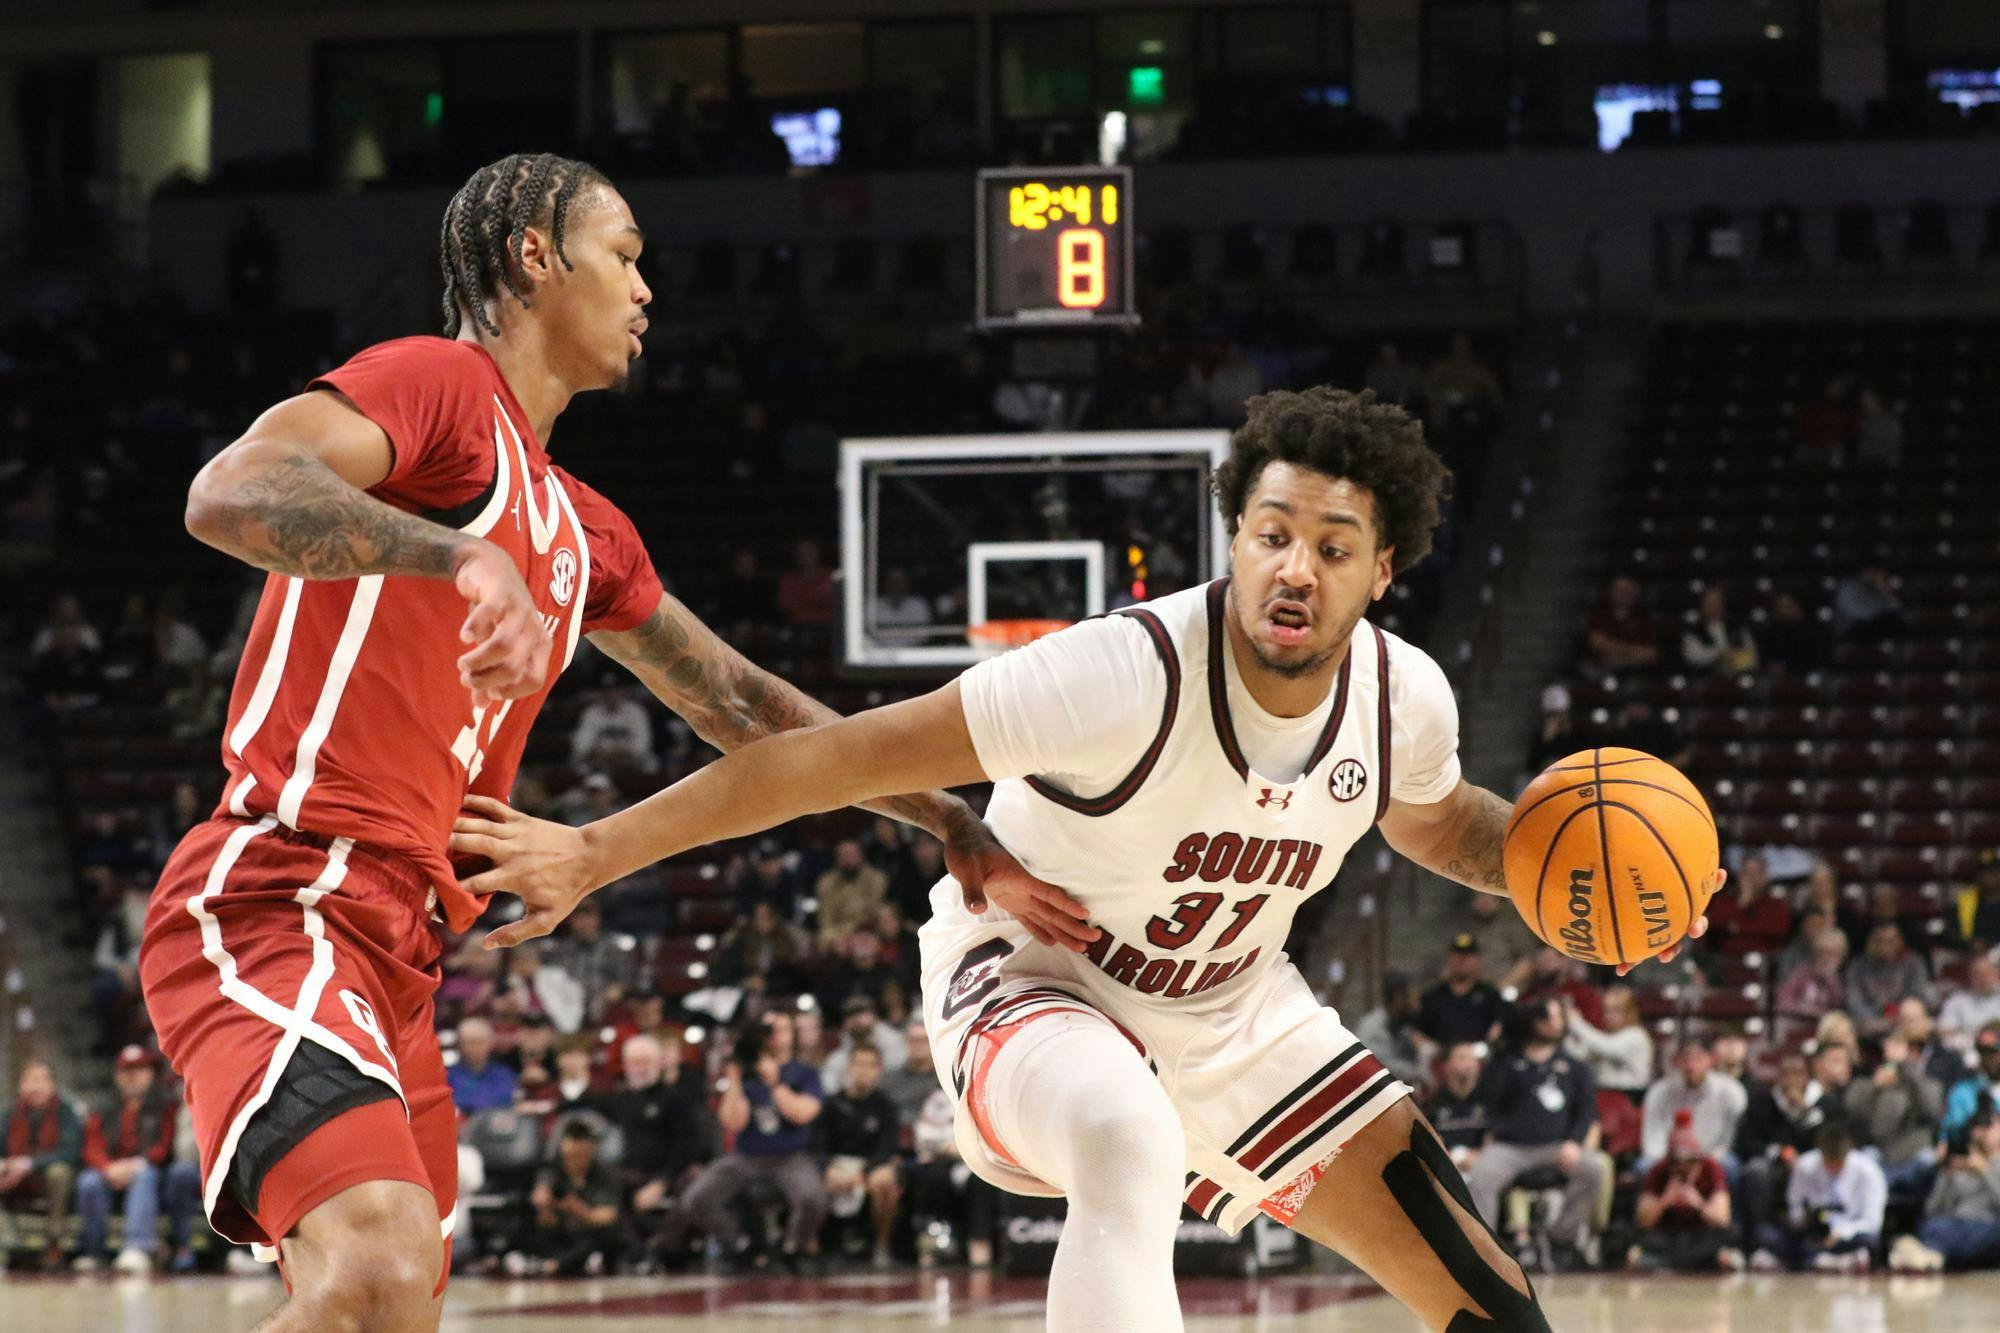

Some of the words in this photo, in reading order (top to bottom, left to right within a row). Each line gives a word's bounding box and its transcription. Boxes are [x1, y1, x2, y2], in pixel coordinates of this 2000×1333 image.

[1010, 183, 1117, 230] 12:41
[1058, 229, 1105, 308] 8
[550, 548, 577, 605] SEC
[1330, 759, 1366, 801] SEC
[1163, 832, 1323, 890] SOUTH
[1628, 867, 1645, 891] NXT
[1145, 892, 1271, 953] 31
[1082, 924, 1262, 999] AROLIN
